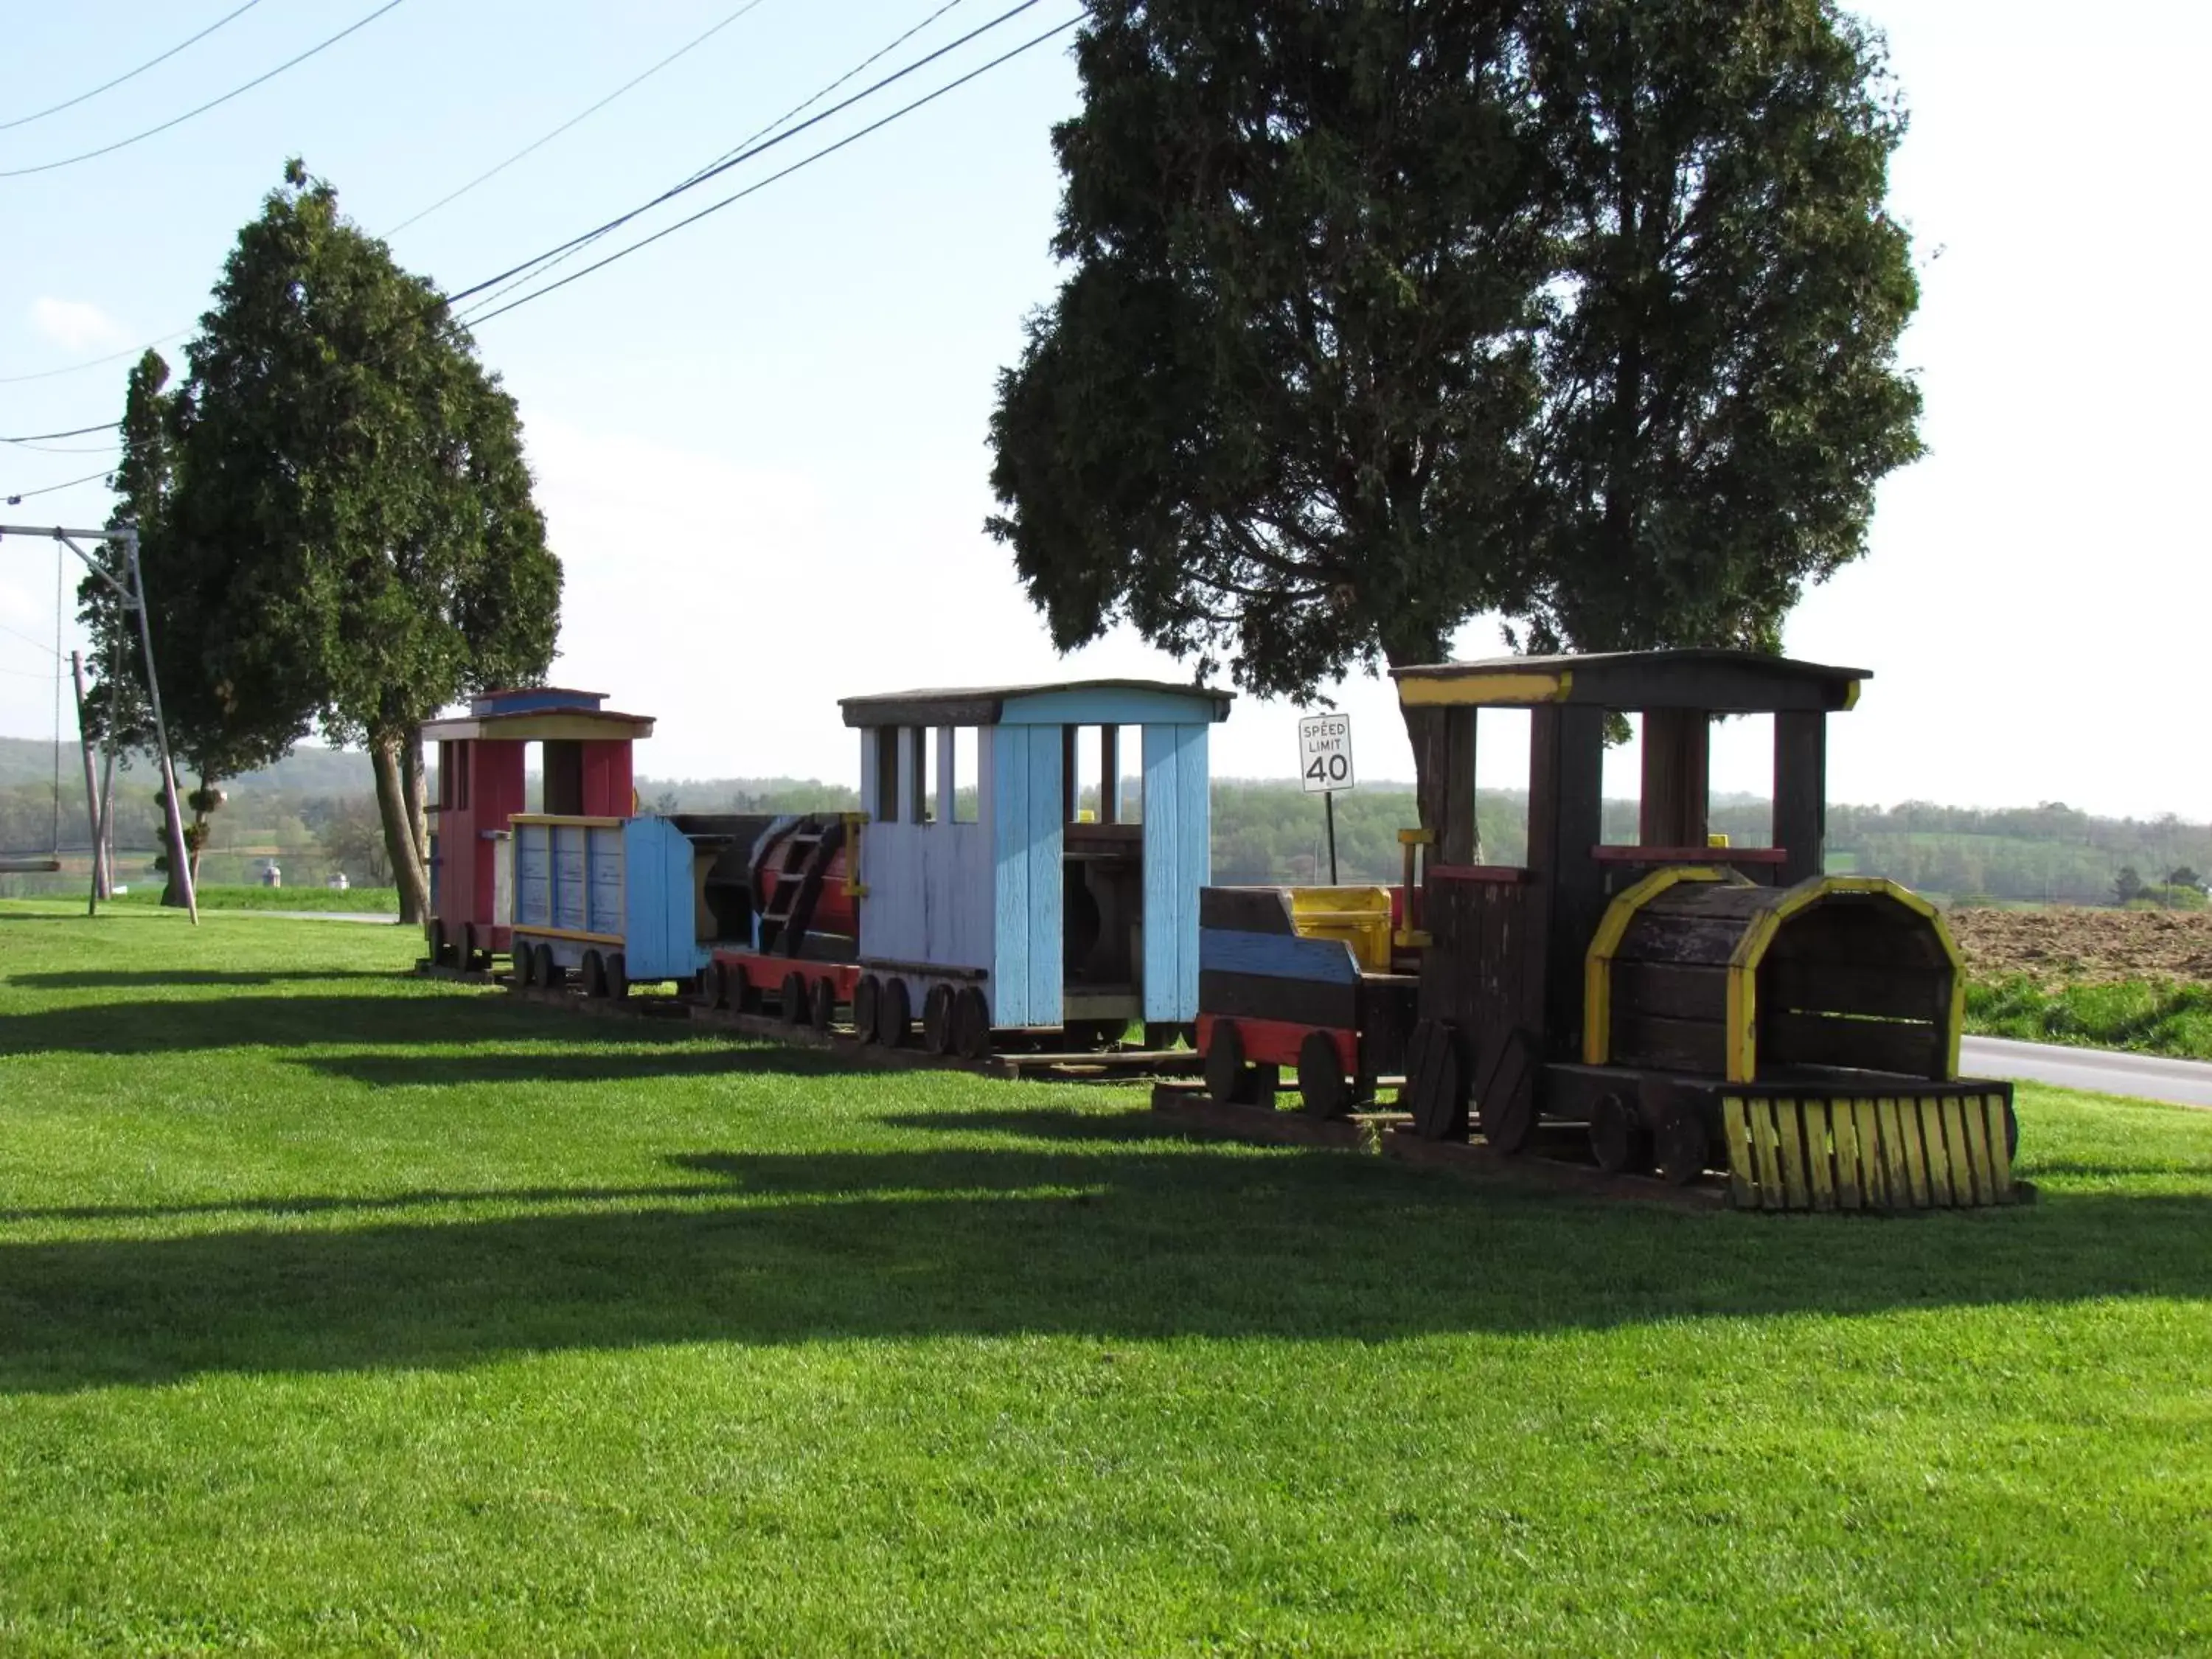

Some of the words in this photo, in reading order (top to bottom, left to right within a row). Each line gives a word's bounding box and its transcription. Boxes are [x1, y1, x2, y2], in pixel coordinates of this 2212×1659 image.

[1304, 723, 1345, 737] SPEED
[1309, 739, 1340, 753] LIMIT
[1306, 754, 1347, 782] 40
